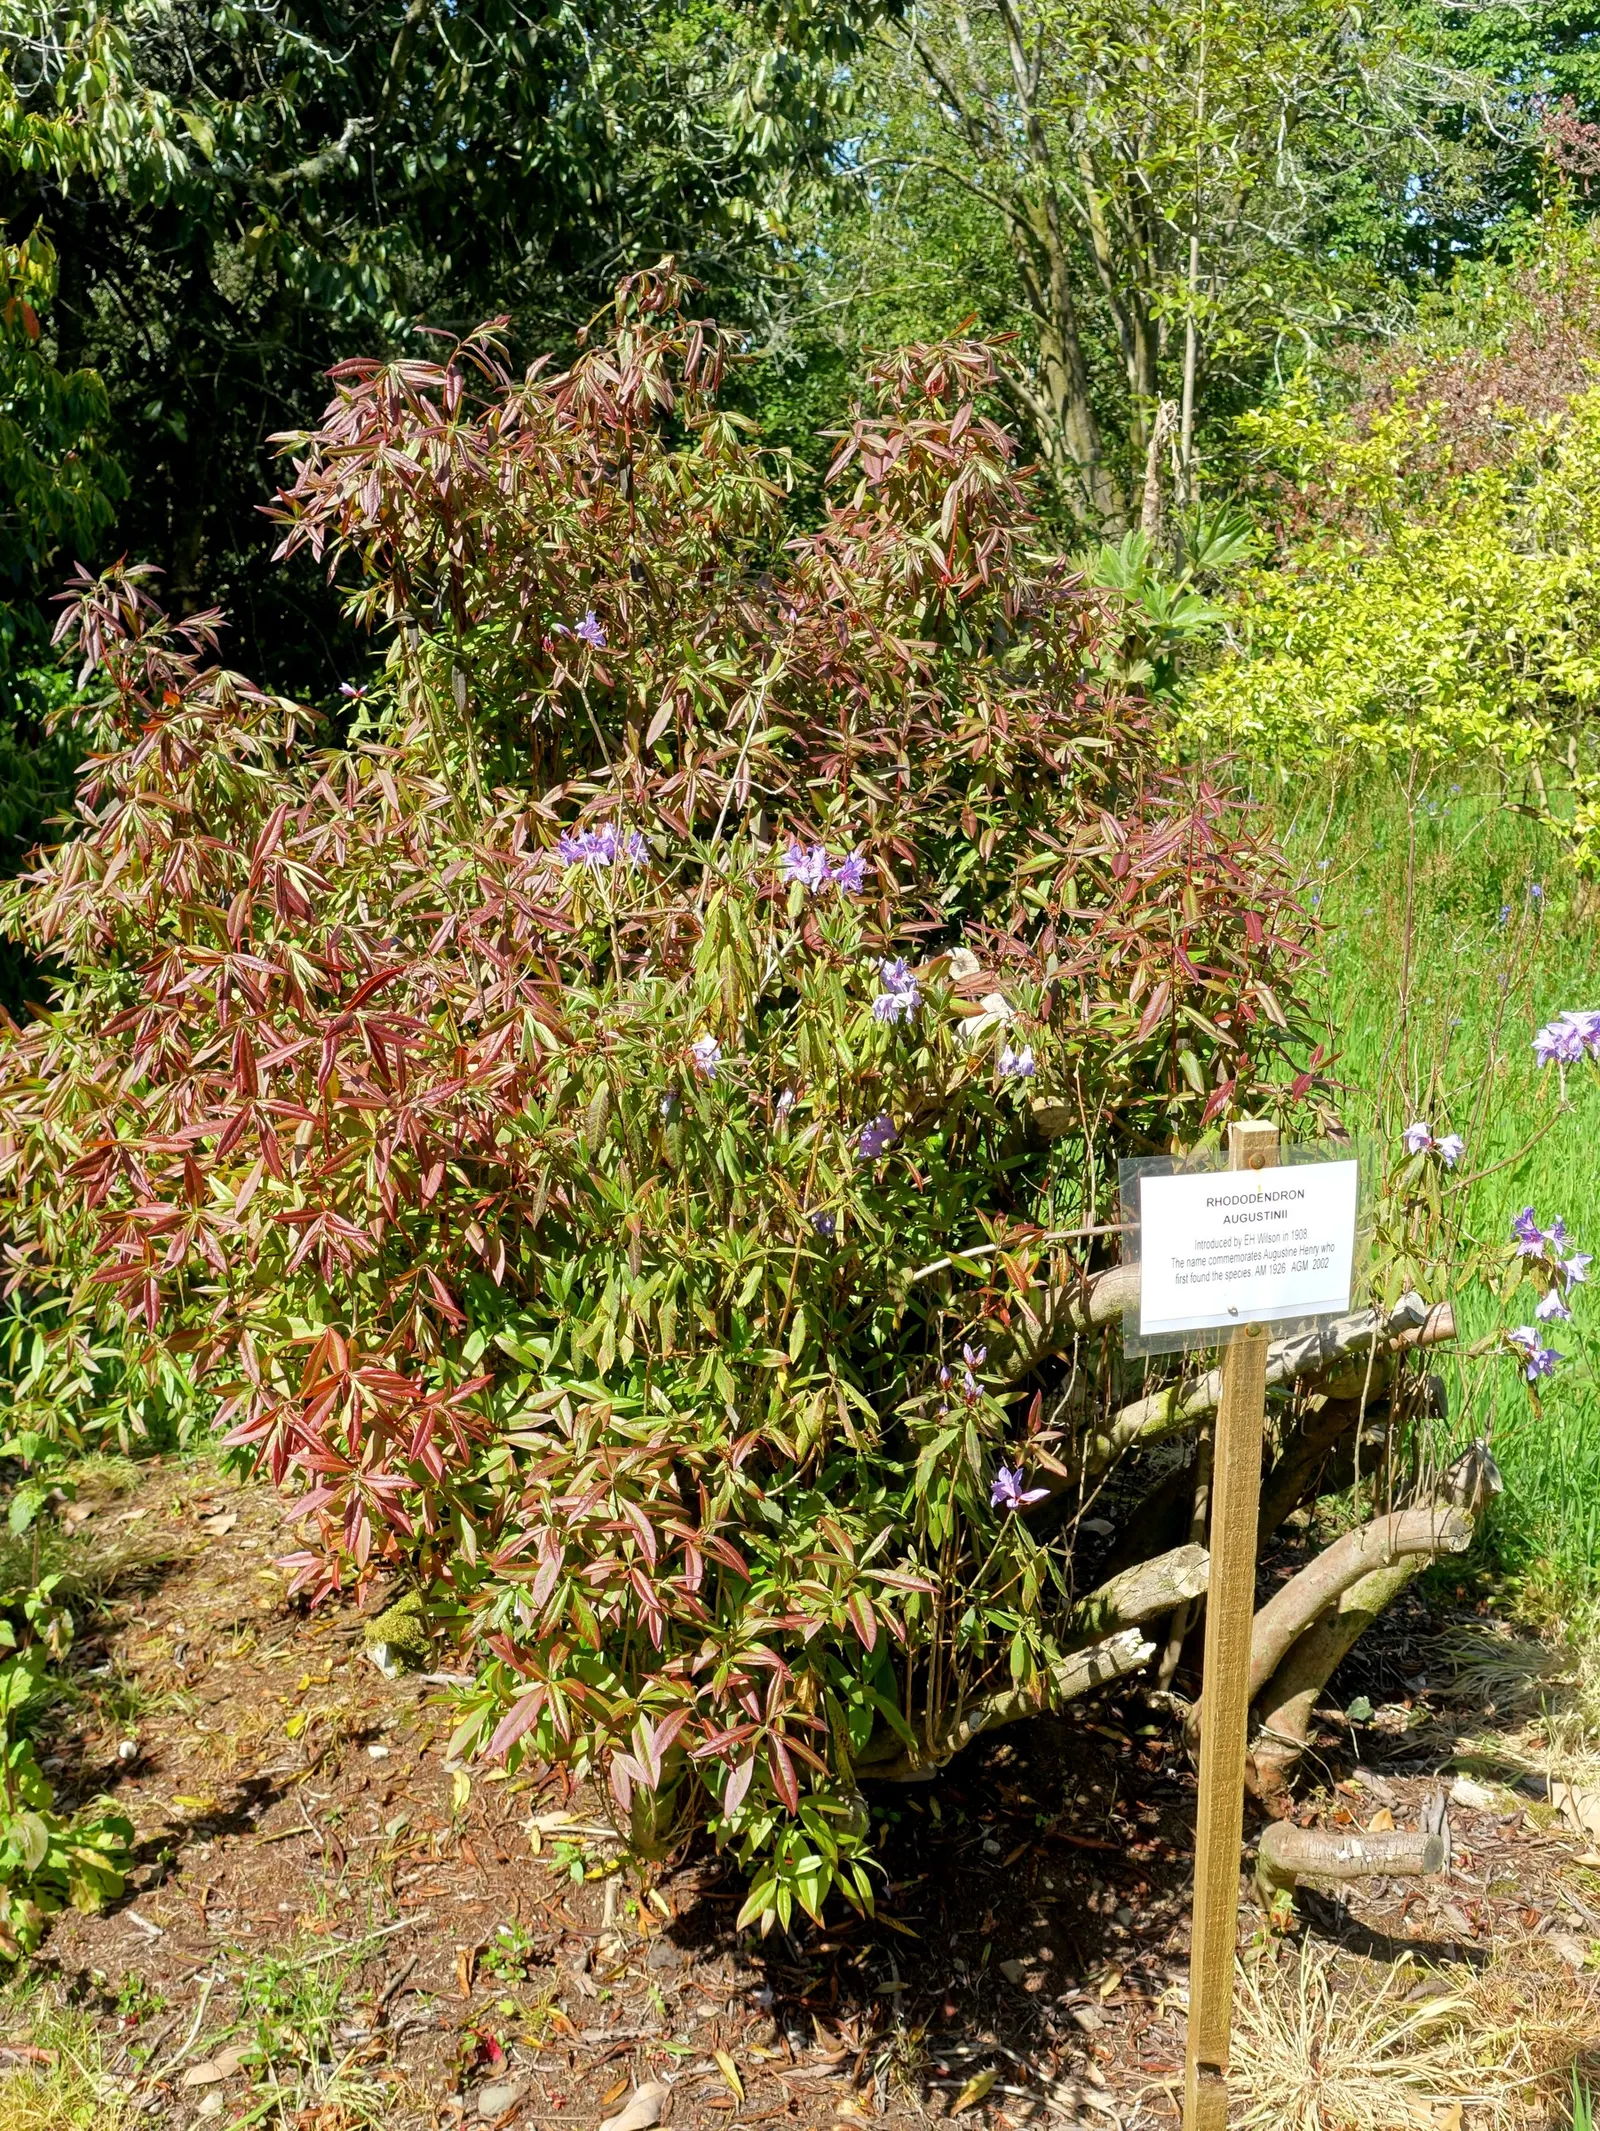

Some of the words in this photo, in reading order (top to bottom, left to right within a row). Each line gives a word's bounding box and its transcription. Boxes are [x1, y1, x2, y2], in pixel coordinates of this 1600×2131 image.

[1206, 1189, 1305, 1207] RHODODENDRON
[1223, 1209, 1288, 1224] AUGUSTINII
[1195, 1236, 1232, 1250] Introduced
[1234, 1236, 1242, 1249] by
[1244, 1233, 1256, 1246] EH
[1257, 1231, 1280, 1244] Wilson
[1283, 1231, 1289, 1242] in
[1171, 1257, 1185, 1269] The
[1187, 1257, 1206, 1268] name
[1208, 1251, 1262, 1266] commemorates
[1263, 1246, 1298, 1261] Augustine
[1299, 1244, 1319, 1257] Henry
[1321, 1242, 1336, 1253] who
[1175, 1273, 1189, 1285] first
[1190, 1270, 1210, 1284] found
[1212, 1270, 1223, 1281] the
[1255, 1264, 1267, 1277] AM
[1269, 1262, 1287, 1275] 1926
[1291, 1260, 1309, 1272] AGM
[1312, 1257, 1330, 1270] 2002
